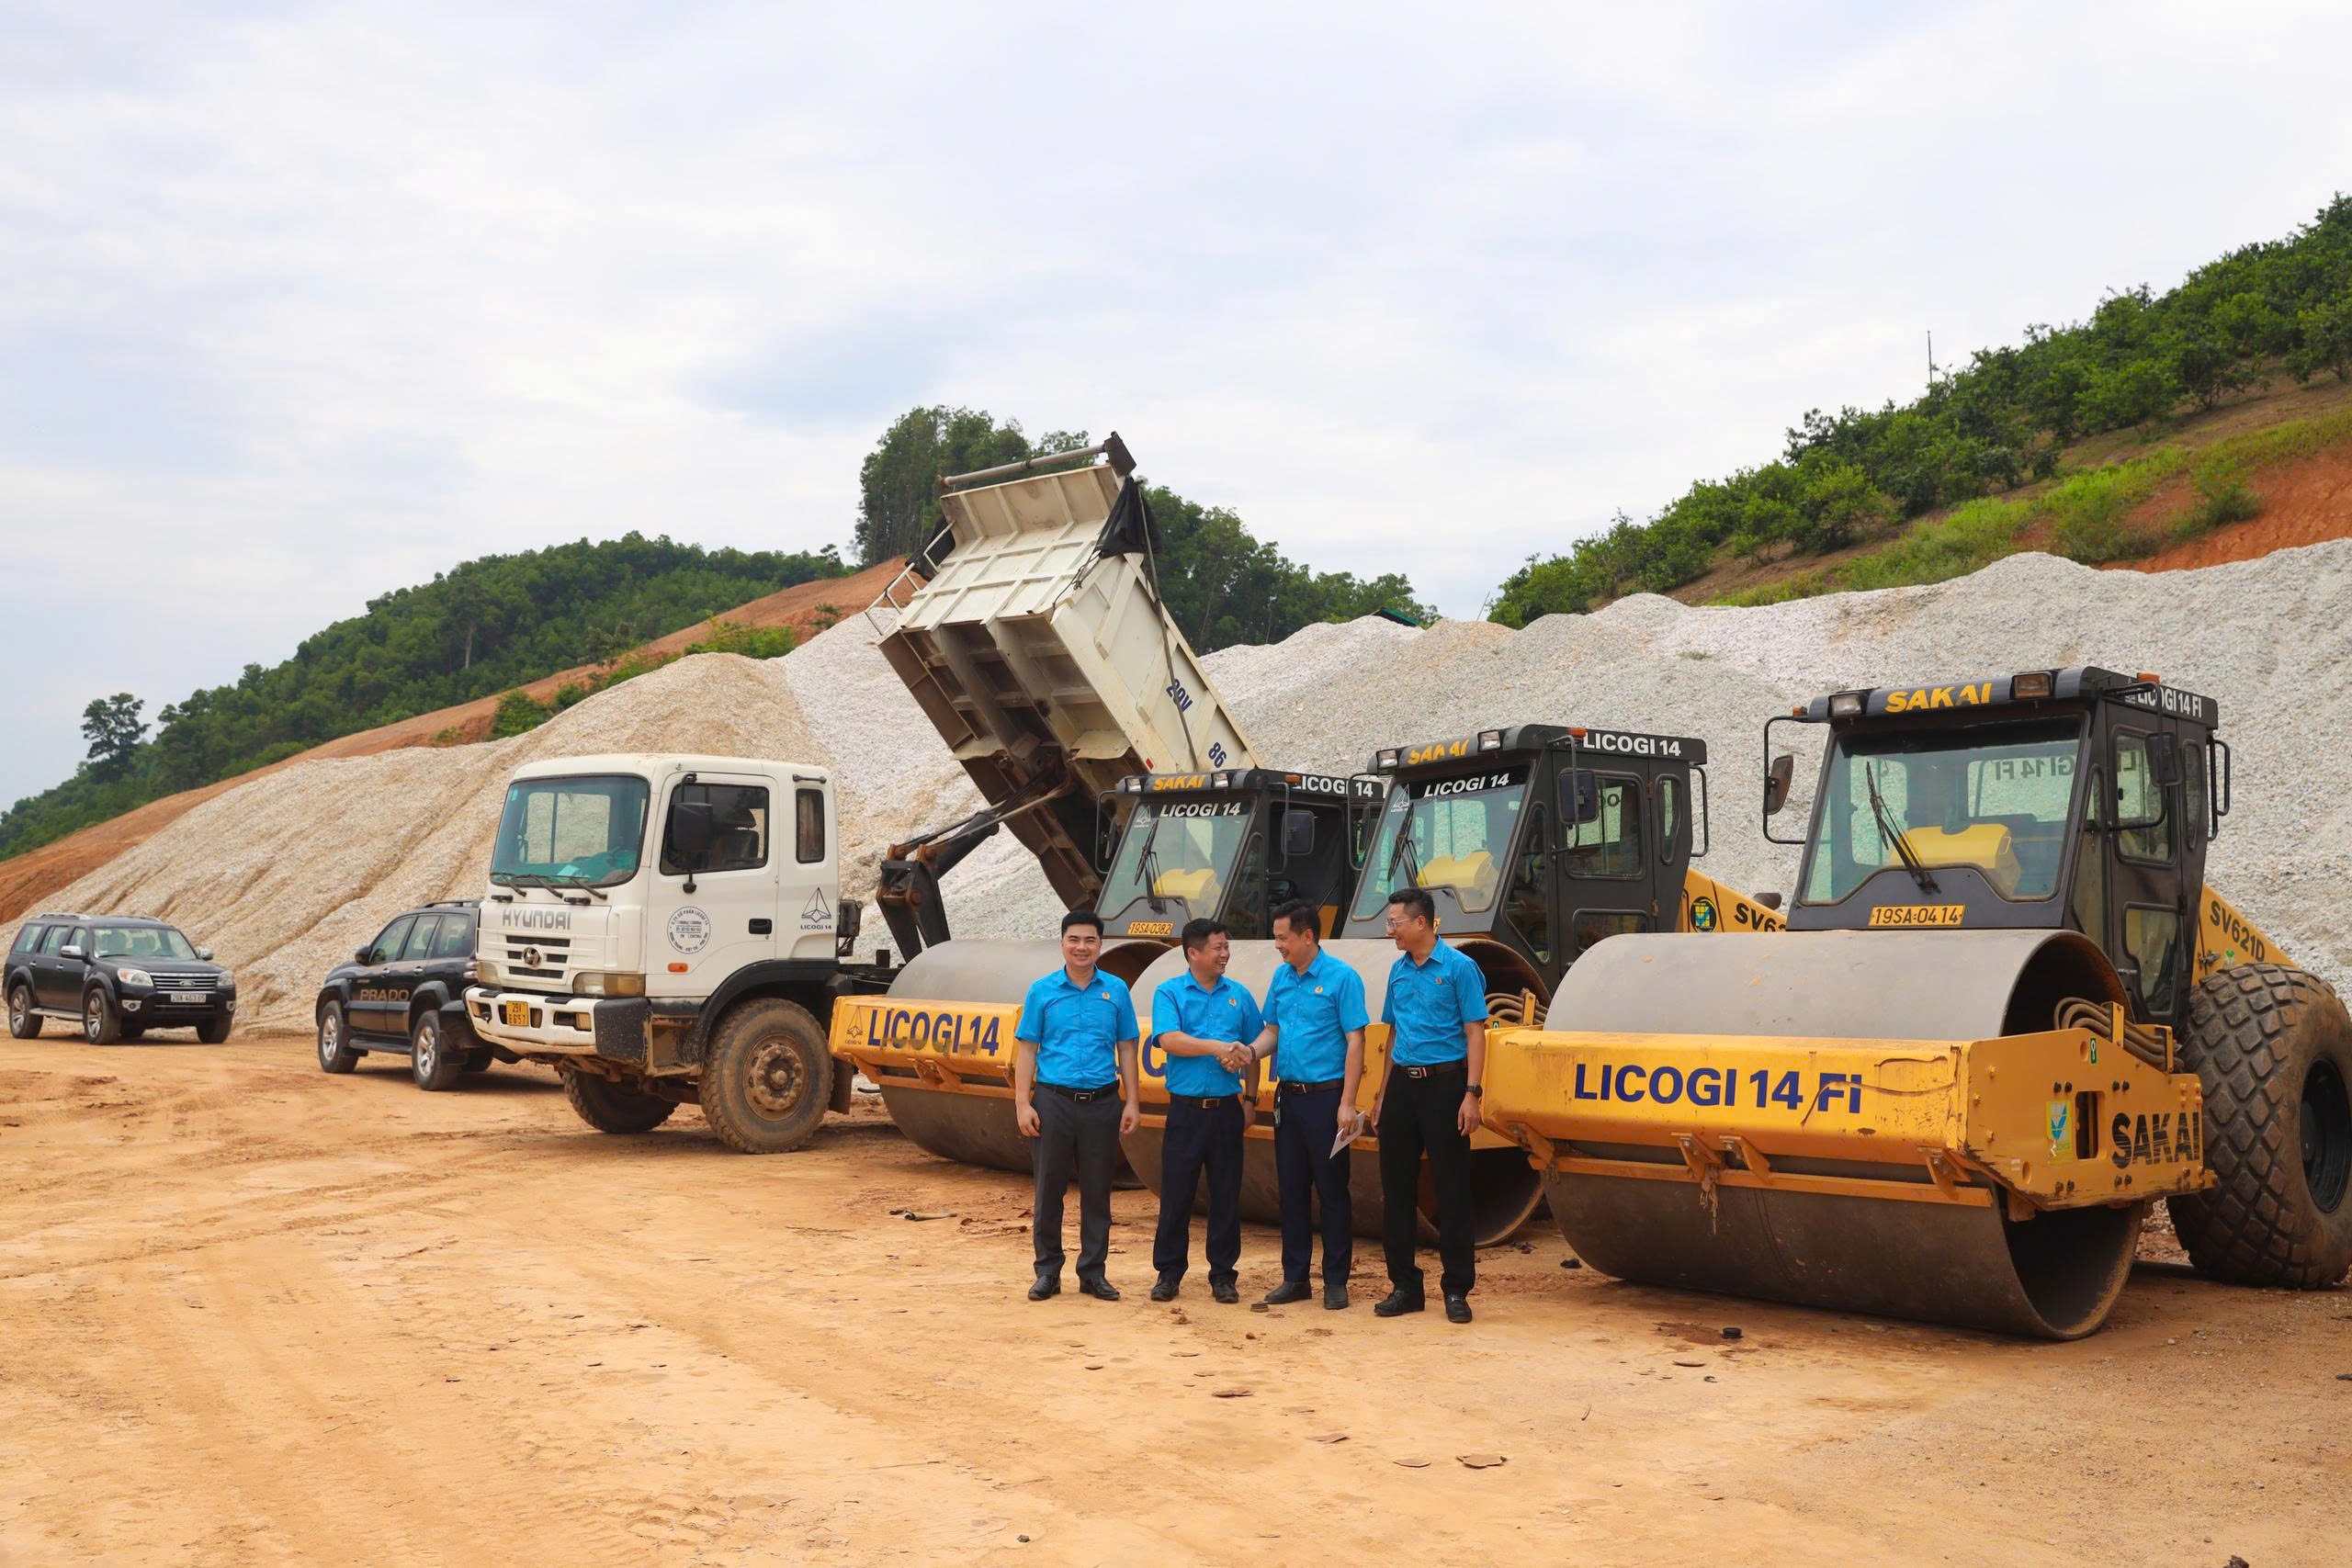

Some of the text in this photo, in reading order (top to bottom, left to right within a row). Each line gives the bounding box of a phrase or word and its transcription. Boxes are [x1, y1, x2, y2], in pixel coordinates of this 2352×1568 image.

[1884, 682, 1993, 713] SAKAI
[2178, 693, 2190, 715] 14
[2192, 695, 2202, 717] FI
[1208, 742, 1227, 768] 86
[1583, 732, 1682, 756] LICOGI 14
[1152, 774, 1205, 791] SAKAI
[1355, 782, 1374, 797] 14
[1423, 773, 1510, 798] LICOGI 14
[1159, 802, 1242, 818] LICOGI 14
[503, 908, 571, 931] HYUNDAI
[2210, 900, 2265, 963] SV621D
[359, 988, 410, 1001] PRADO
[867, 1010, 1000, 1057] LICOGI 14
[1574, 1064, 1862, 1114] LICOGI 14 FI
[2111, 1111, 2199, 1169] SAKAI
